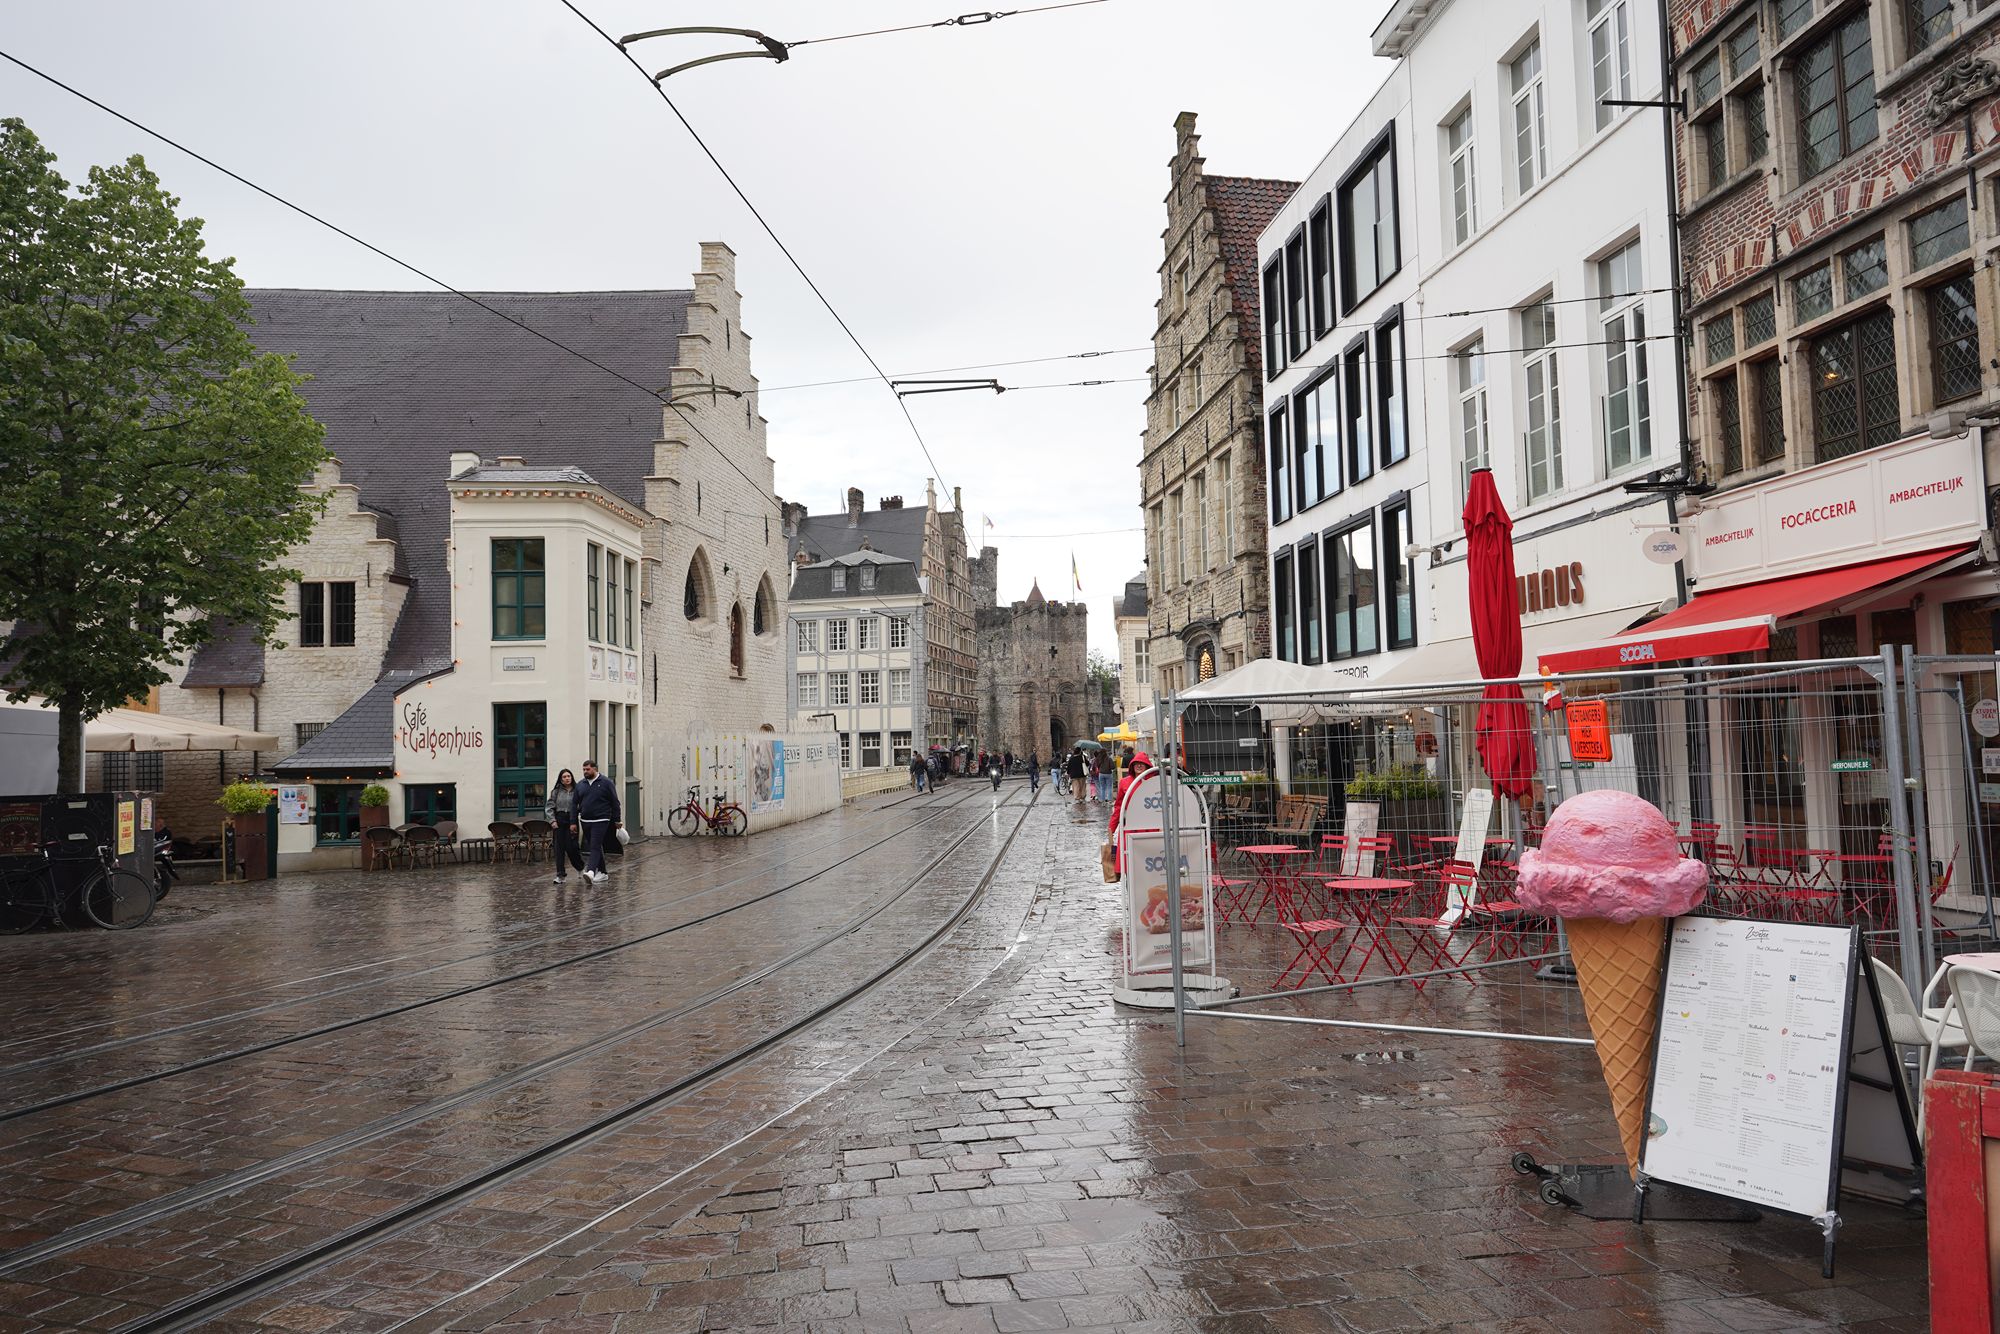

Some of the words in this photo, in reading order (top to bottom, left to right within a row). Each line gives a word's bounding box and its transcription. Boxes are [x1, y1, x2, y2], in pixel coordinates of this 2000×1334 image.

[1889, 476, 1963, 505] AMBACHTELIJK
[1781, 500, 1857, 530] FOCACCERIA
[1652, 543, 1677, 552] SCOPA
[1705, 528, 1755, 547] AMBACHTELIJK
[1619, 644, 1656, 662] SCOPA
[403, 702, 427, 731] Café
[409, 726, 483, 760] Galgenhuis
[1832, 761, 1869, 769] WERFONLINE.BE
